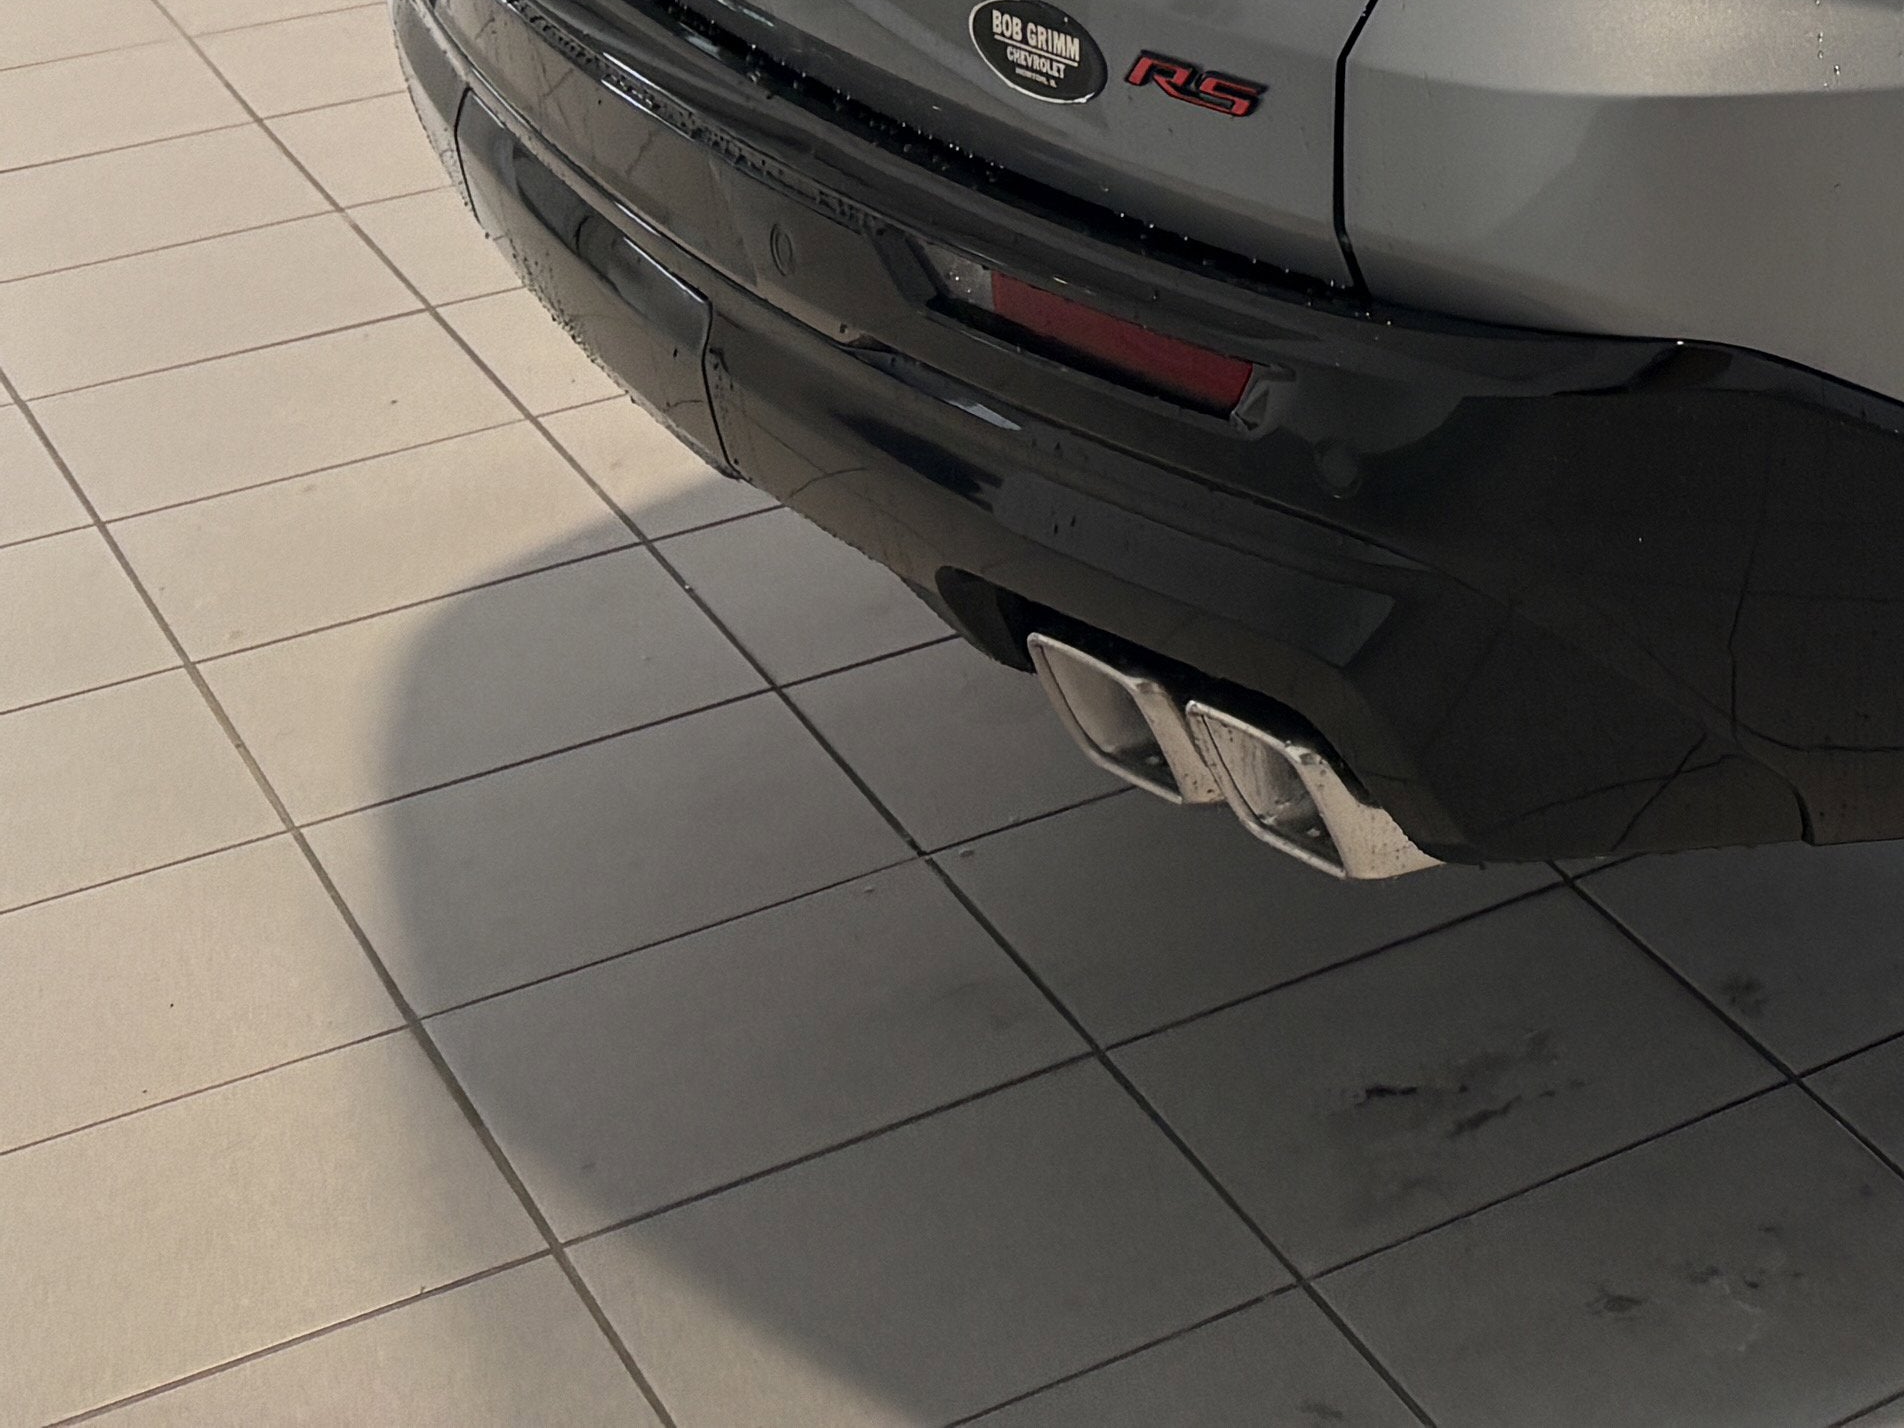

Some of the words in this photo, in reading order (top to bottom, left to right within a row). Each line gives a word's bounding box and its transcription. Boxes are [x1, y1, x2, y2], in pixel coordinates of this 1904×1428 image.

[992, 9, 1023, 41] BOB
[1026, 22, 1080, 62] GRIMM
[1006, 46, 1066, 79] CHEVROLET
[1124, 49, 1270, 117] RS
